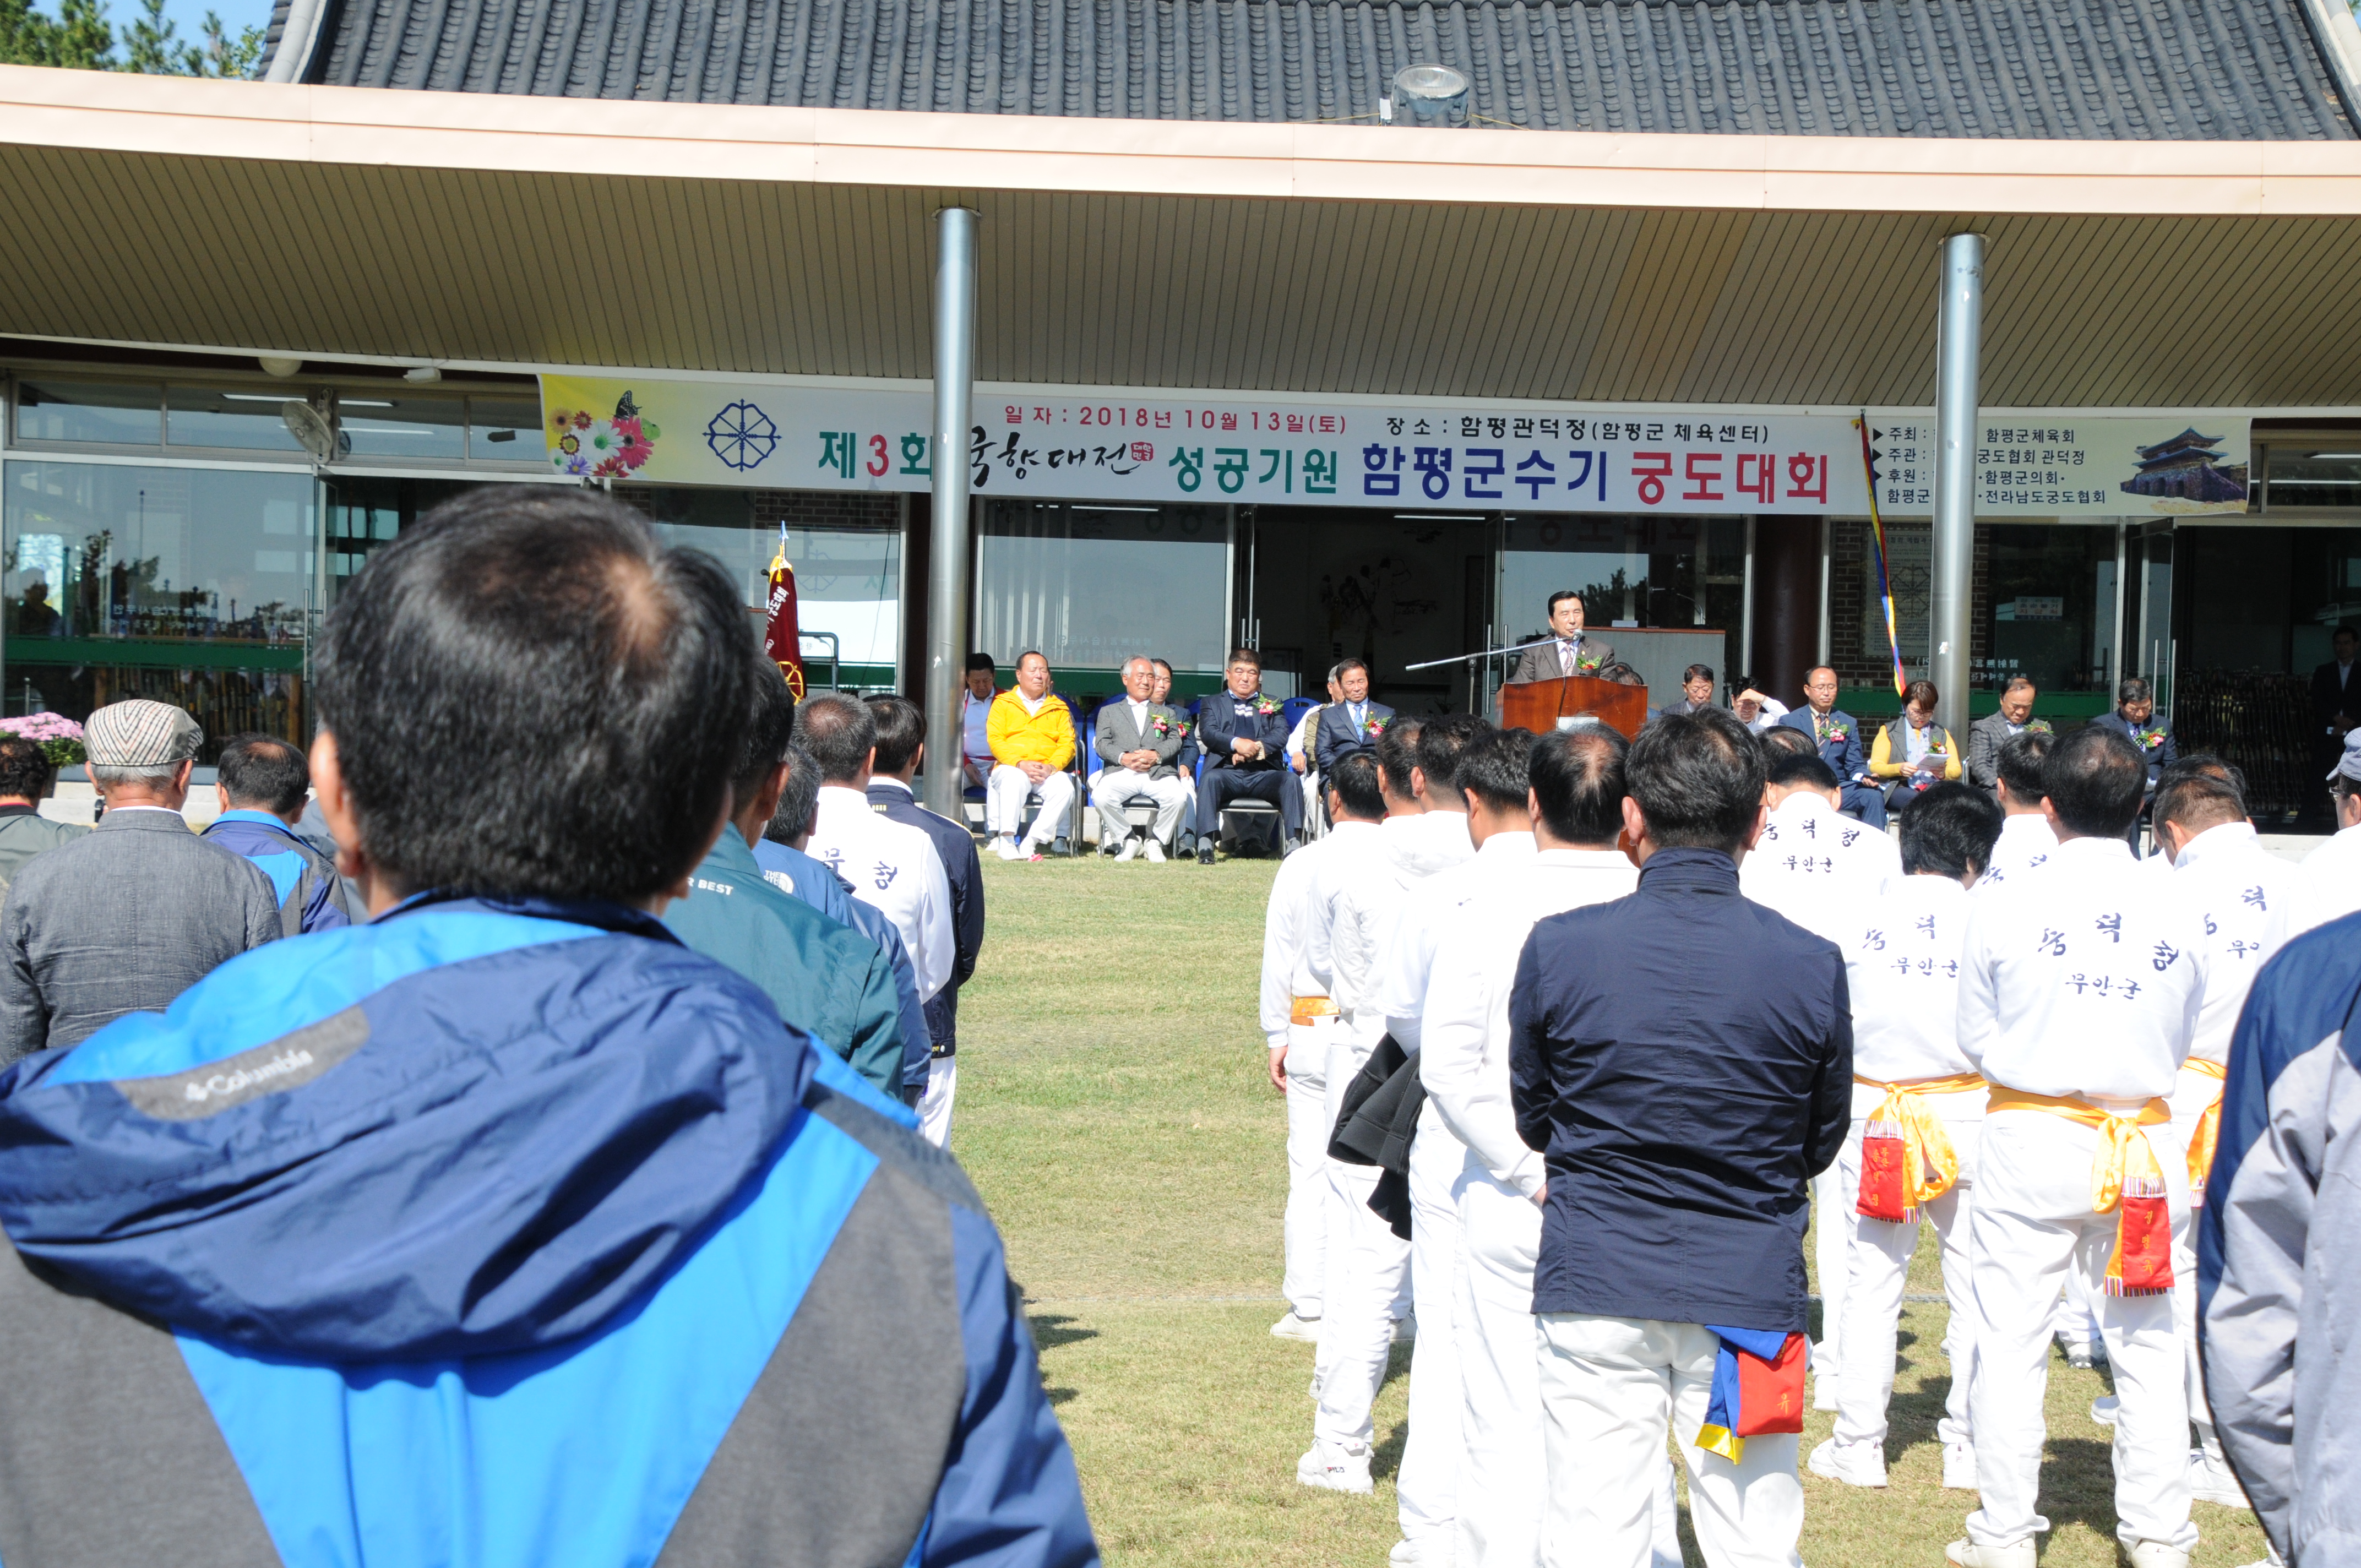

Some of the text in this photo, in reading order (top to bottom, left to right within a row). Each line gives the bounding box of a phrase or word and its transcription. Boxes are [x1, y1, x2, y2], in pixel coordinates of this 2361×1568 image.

[1080, 406, 1171, 429] 2018년
[1184, 409, 1237, 431] 10월
[1250, 412, 1346, 434] 13일(토)
[1985, 428, 2075, 444] 함평군체육회
[970, 425, 1828, 505] 국향대전 성공기원 함평군수기 궁도대회
[2041, 451, 2086, 465] 관덕정
[1782, 855, 1834, 873] 무안군
[698, 879, 734, 896] BEST
[1890, 957, 1959, 978] 무안군
[2065, 973, 2142, 1000] 무안군
[205, 1049, 313, 1096] Columbia
